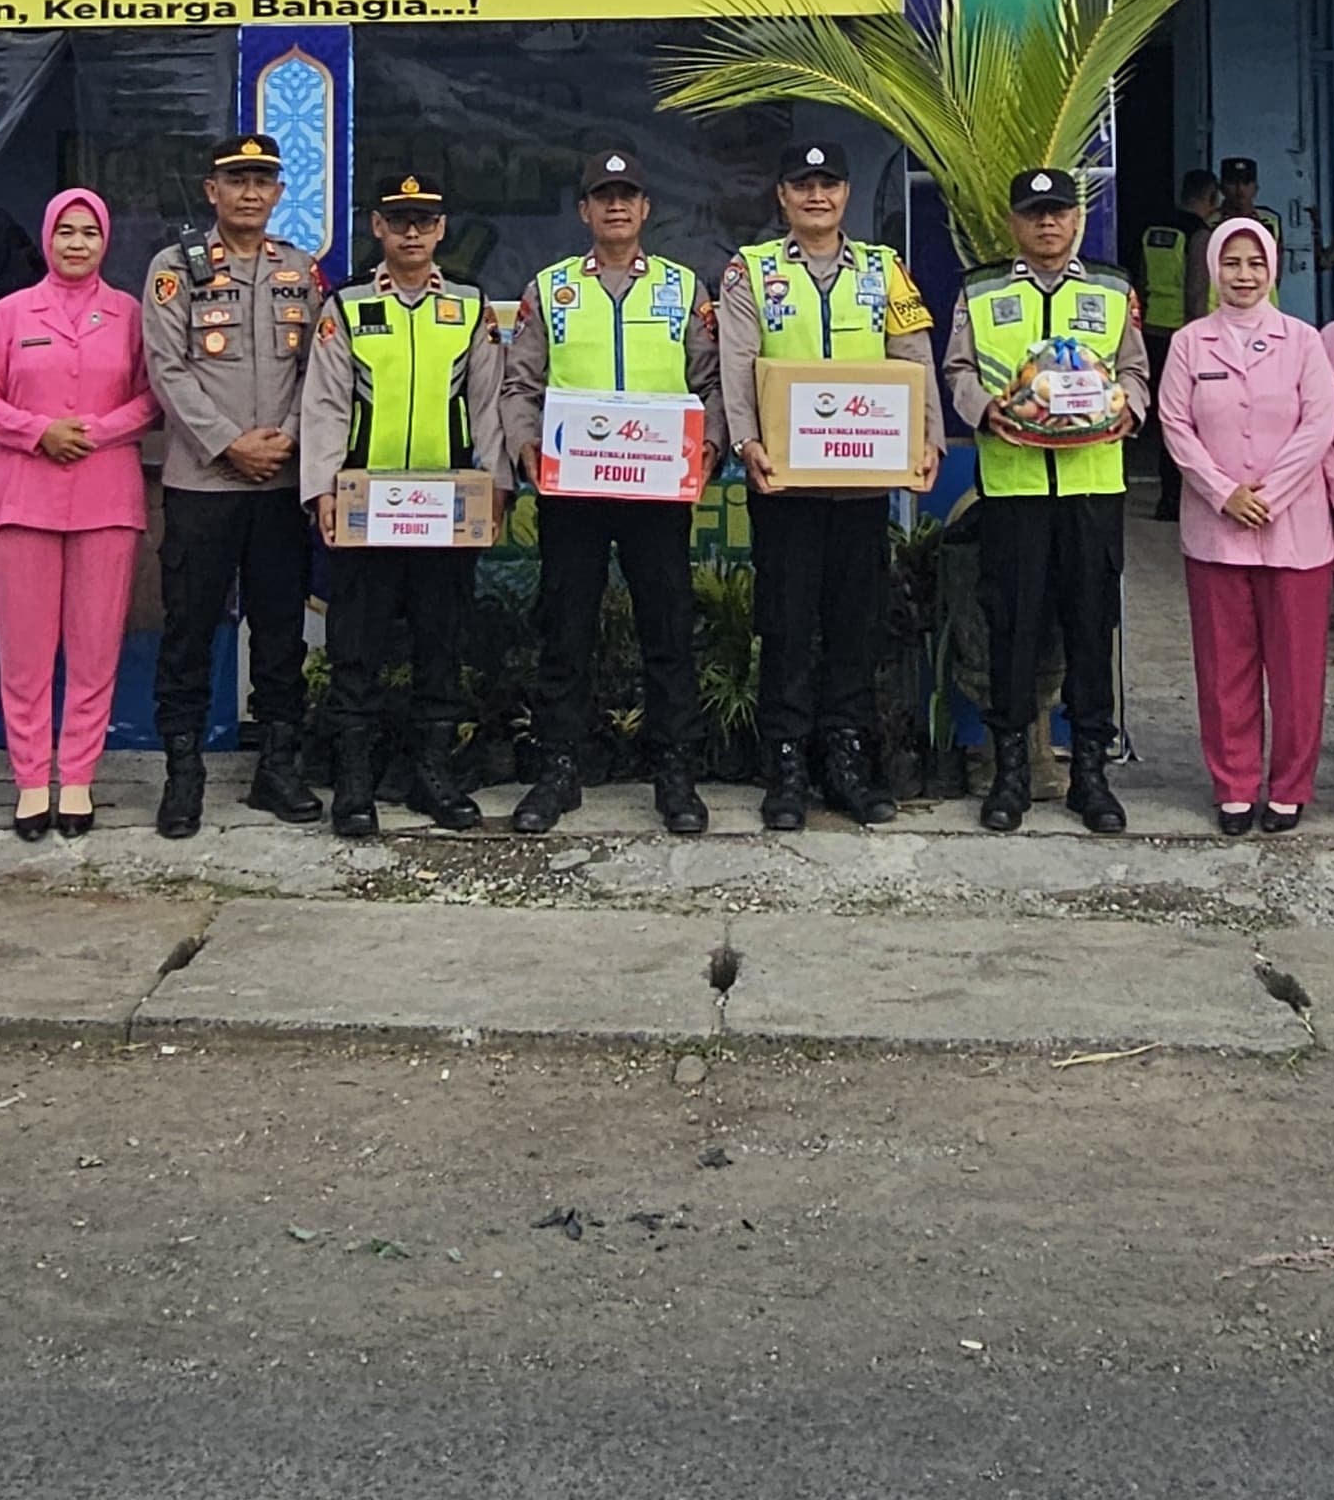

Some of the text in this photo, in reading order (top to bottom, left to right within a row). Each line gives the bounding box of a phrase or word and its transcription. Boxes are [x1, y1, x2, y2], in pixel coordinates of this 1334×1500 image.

[190, 288, 241, 303] MUFTI
[843, 395, 870, 417] 46
[616, 419, 644, 442] 46
[823, 441, 874, 459] PEDULI
[594, 464, 646, 484] PEDULI
[392, 522, 430, 536] PEDULI
